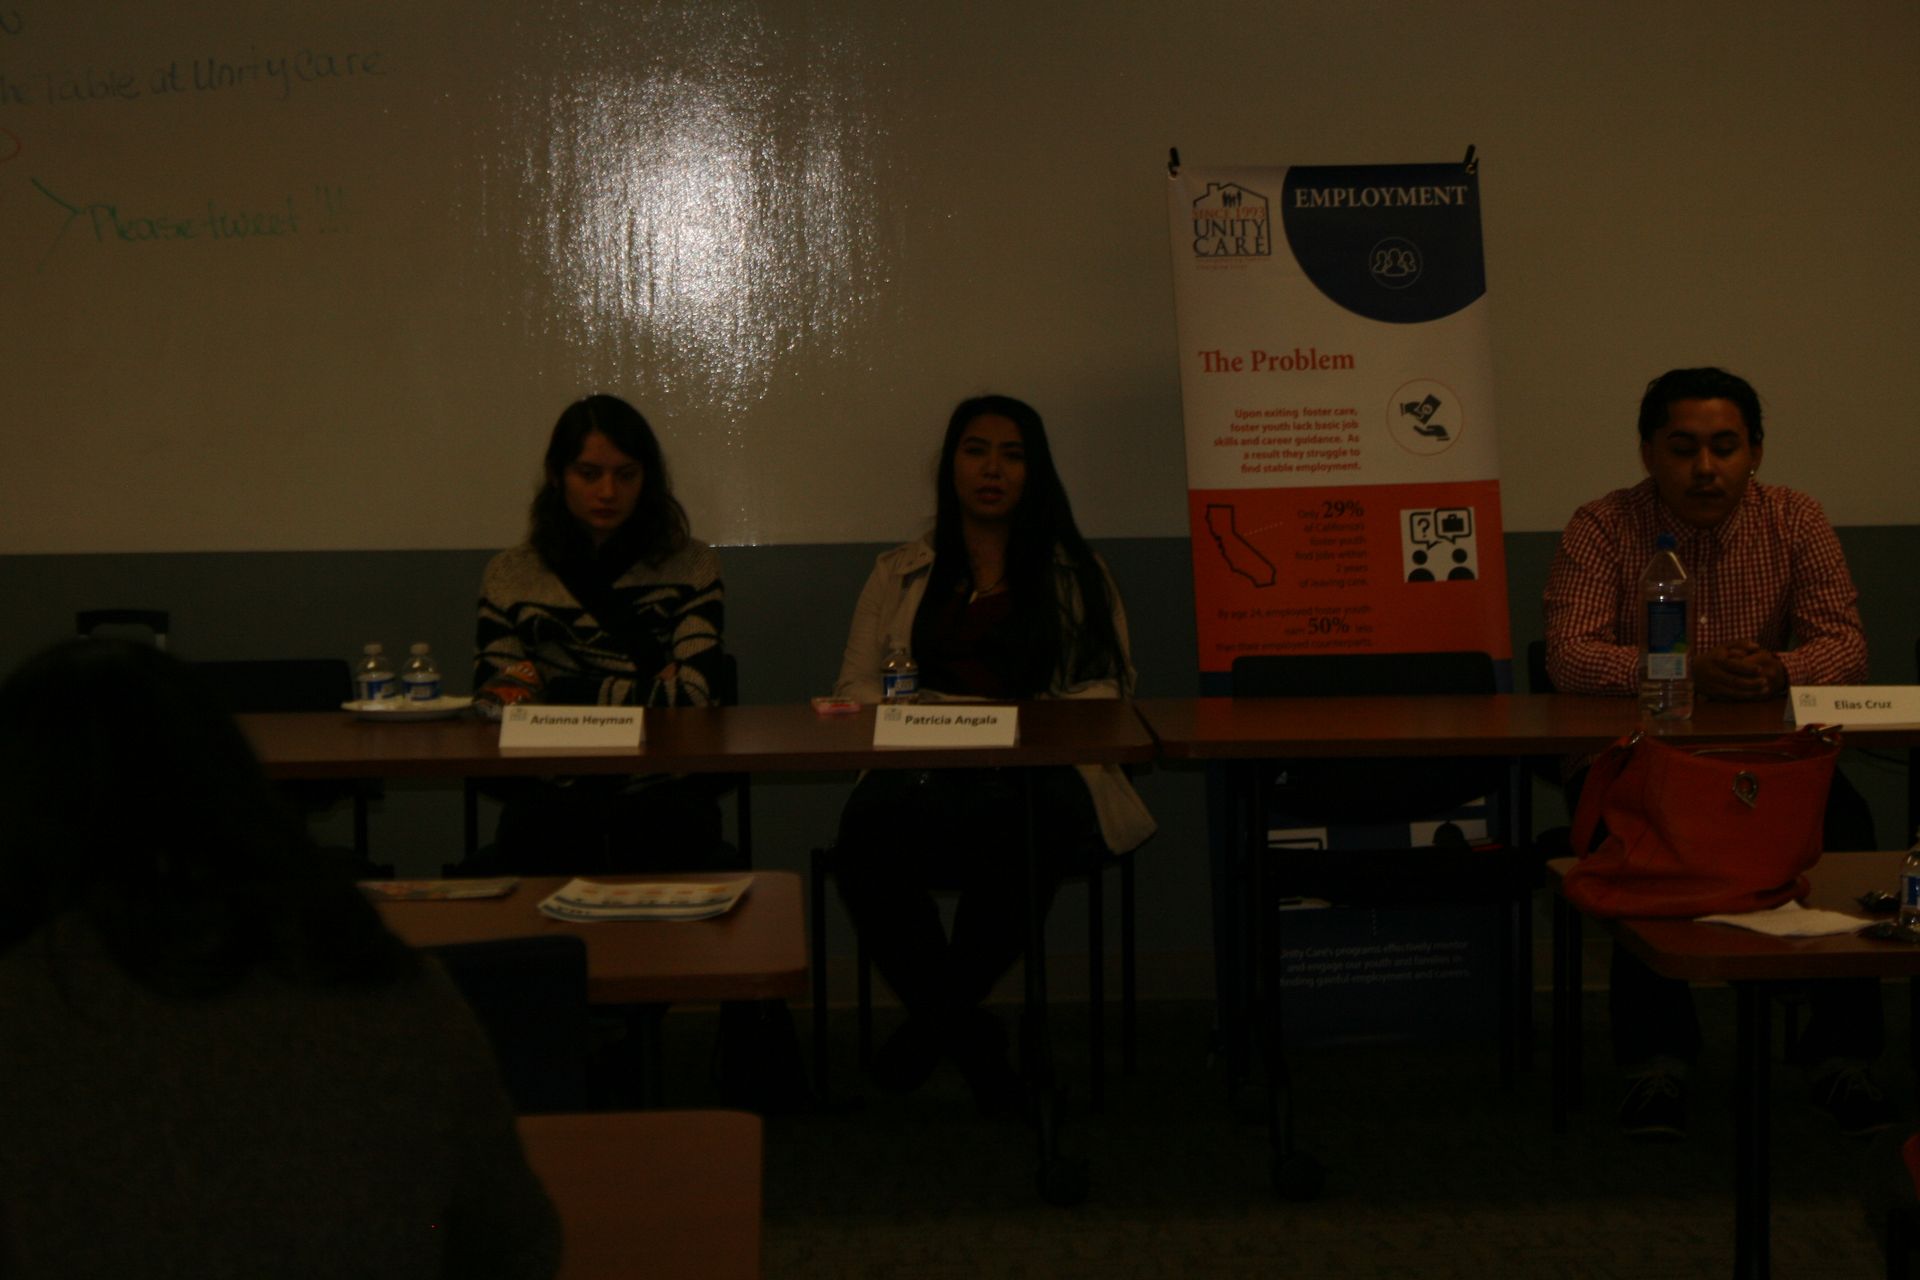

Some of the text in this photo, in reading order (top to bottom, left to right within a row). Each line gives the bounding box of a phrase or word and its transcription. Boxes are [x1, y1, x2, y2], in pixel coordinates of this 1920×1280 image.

[1294, 185, 1468, 208] EMPLOYMENT
[1193, 218, 1265, 238] UNITY
[1192, 237, 1265, 256] CARE
[1198, 347, 1355, 373] The Problem
[1234, 406, 1358, 420] Upon exiting foster care,
[1230, 419, 1359, 433] foster youth lack basic job
[1214, 433, 1359, 446] skills and career guidance. As
[1251, 449, 1280, 460] result
[1282, 448, 1304, 460] they
[1306, 447, 1347, 459] struggle
[1350, 447, 1361, 457] to
[1241, 461, 1361, 474] find stable employment.
[1297, 500, 1365, 520] Only 29%
[1307, 616, 1350, 635] 50%
[1834, 700, 1892, 710] Elias Cruz
[530, 714, 579, 726] Arianna
[582, 714, 634, 727] Heyman
[905, 714, 951, 726] Patricia
[954, 714, 998, 727] Angala
